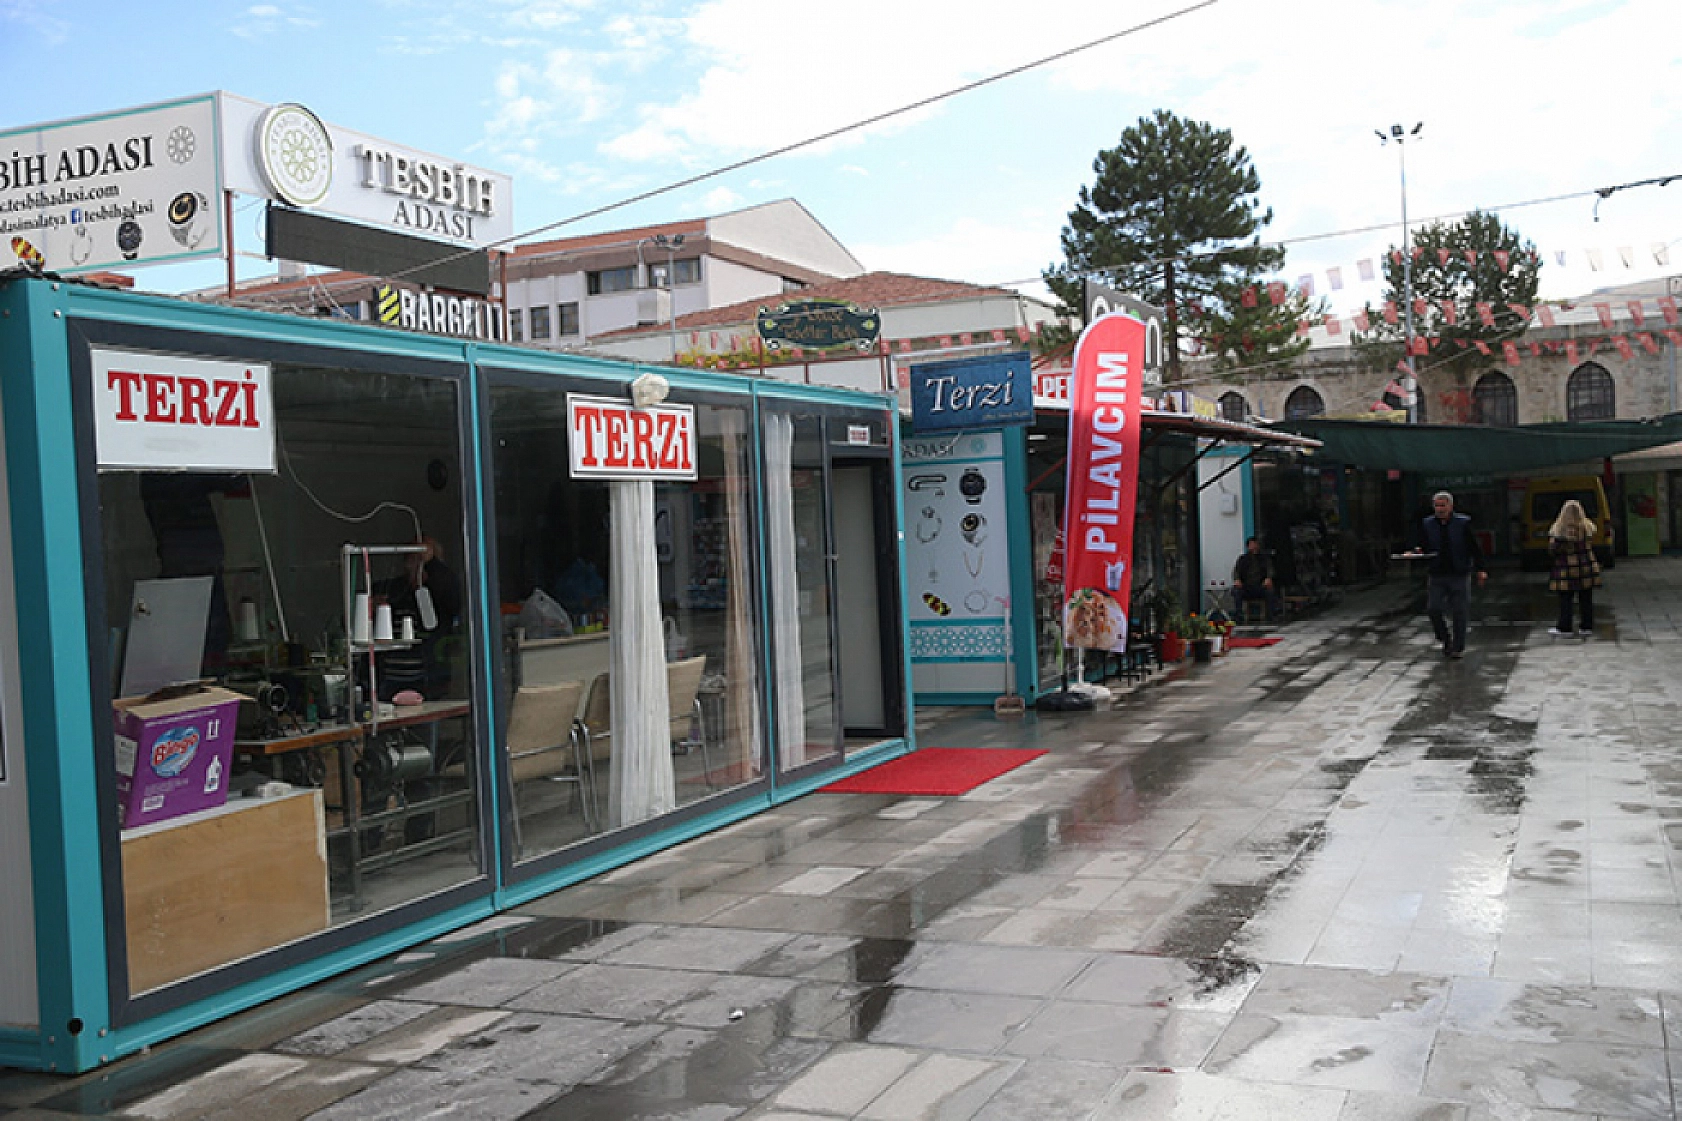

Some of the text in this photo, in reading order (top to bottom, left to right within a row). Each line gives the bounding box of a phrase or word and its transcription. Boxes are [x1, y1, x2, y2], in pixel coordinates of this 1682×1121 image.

[54, 136, 154, 181] ADASI
[355, 143, 495, 217] TESBİH
[393, 199, 475, 240] ADASI
[107, 369, 261, 429] TERZİ
[926, 370, 1014, 414] Terzi
[1084, 352, 1129, 553] PİLAVCIM
